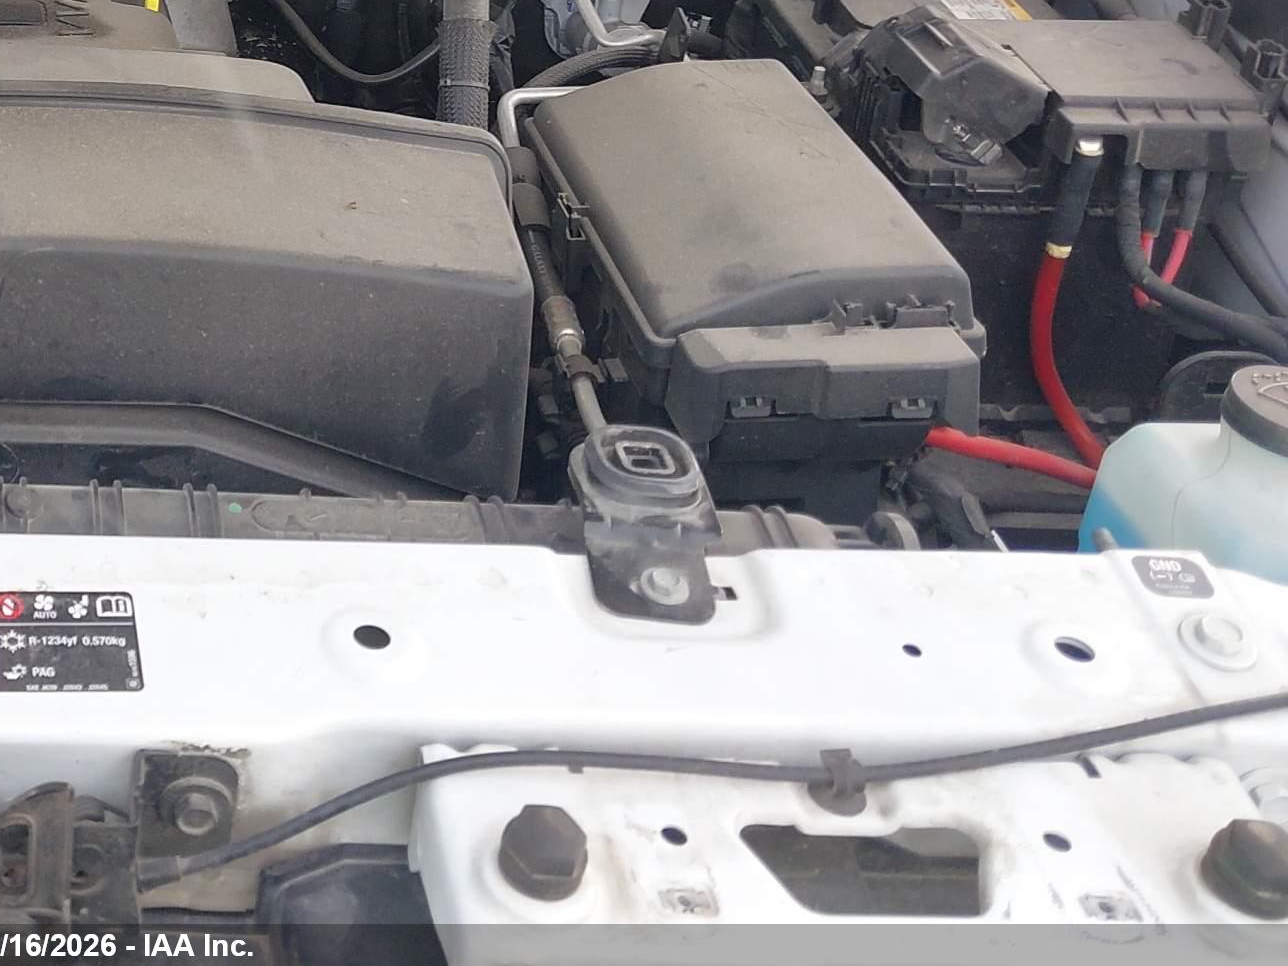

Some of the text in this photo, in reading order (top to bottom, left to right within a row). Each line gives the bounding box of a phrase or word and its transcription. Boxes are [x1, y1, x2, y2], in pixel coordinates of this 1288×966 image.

[33, 610, 57, 619] AUTO
[28, 635, 127, 648] R-1234yf 0.570kg
[31, 666, 56, 678] PAG
